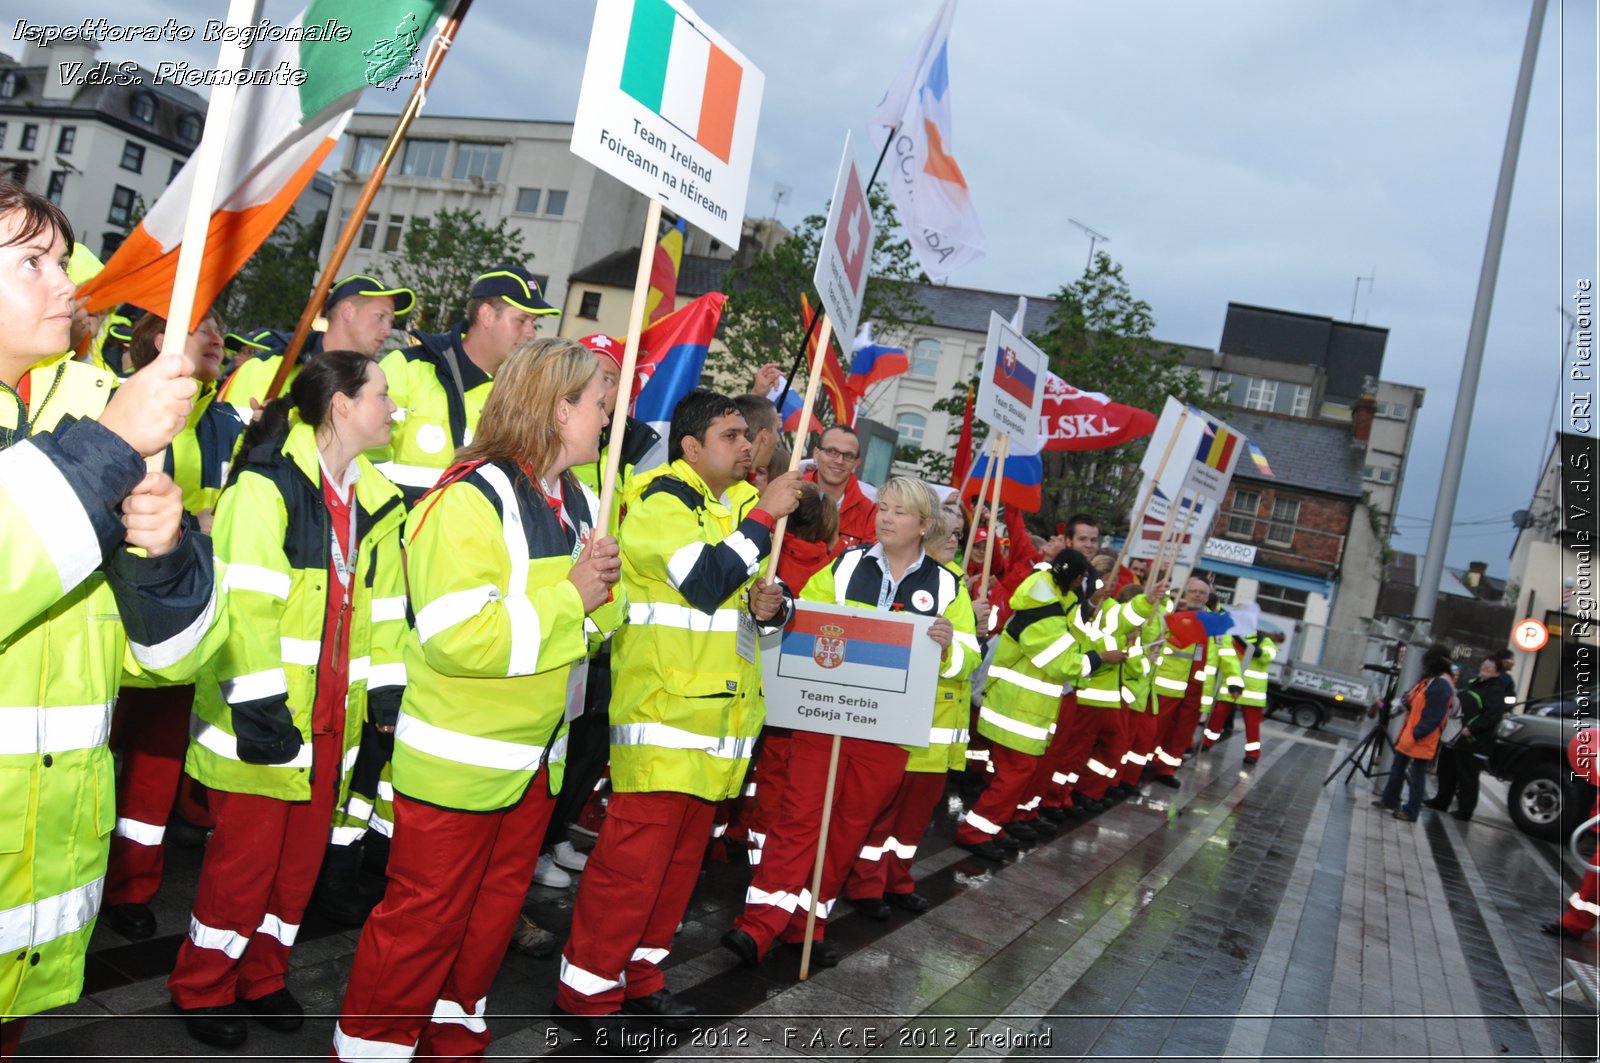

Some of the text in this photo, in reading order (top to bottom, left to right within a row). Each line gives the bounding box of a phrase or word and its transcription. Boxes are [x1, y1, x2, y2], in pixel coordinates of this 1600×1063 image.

[633, 117, 713, 184] Team Ireland
[599, 128, 729, 222] Foireann na hÉireann
[1036, 413, 1121, 440] LSKA
[1205, 540, 1252, 558] DWARD
[800, 689, 879, 710] Team Serbia
[797, 705, 842, 722] Србија
